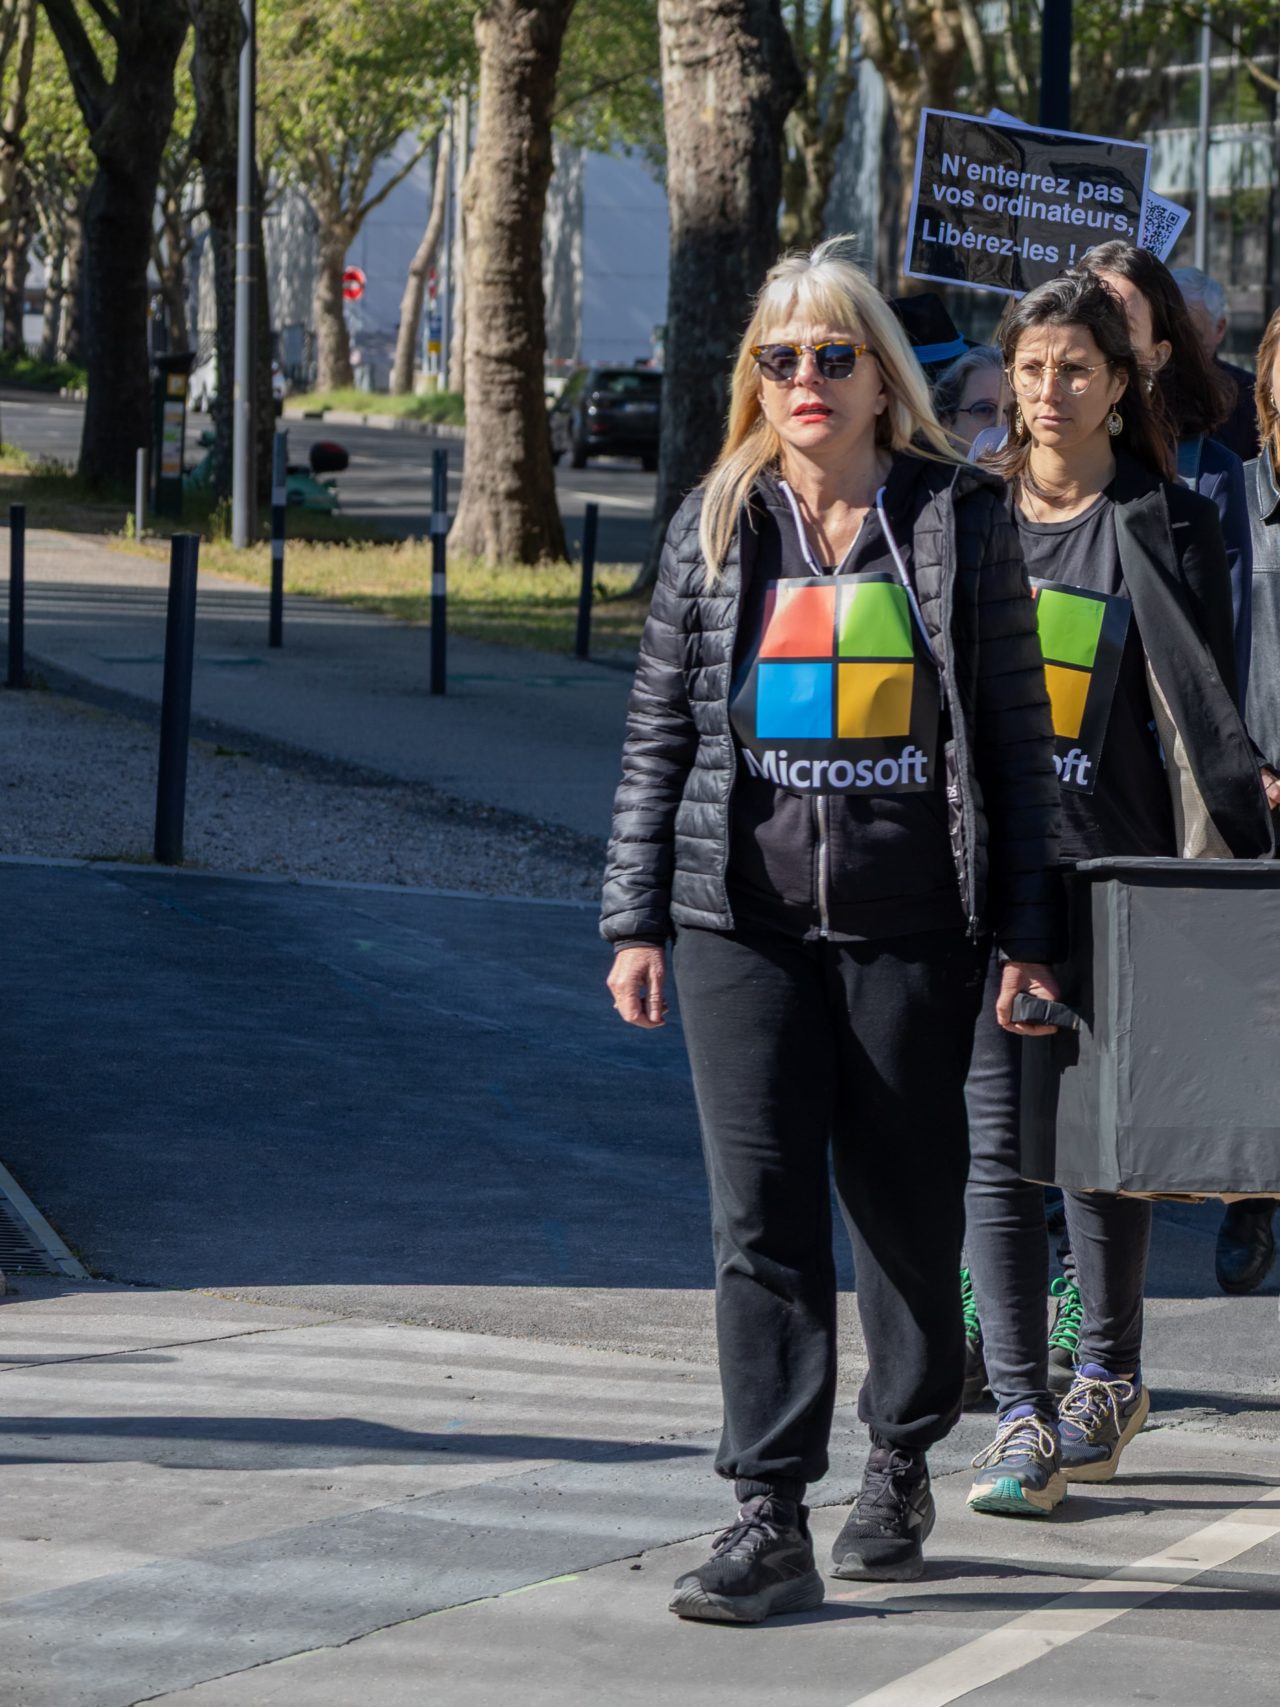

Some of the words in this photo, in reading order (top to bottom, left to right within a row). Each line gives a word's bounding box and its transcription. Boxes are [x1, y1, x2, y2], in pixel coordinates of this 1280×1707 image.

[940, 152, 1070, 196] N'enterrez
[1077, 179, 1125, 205] pas
[932, 184, 976, 206] vos
[982, 189, 1135, 237] ordinateurs,
[922, 217, 1059, 264] Libérez-les
[741, 744, 928, 789] Microsoft
